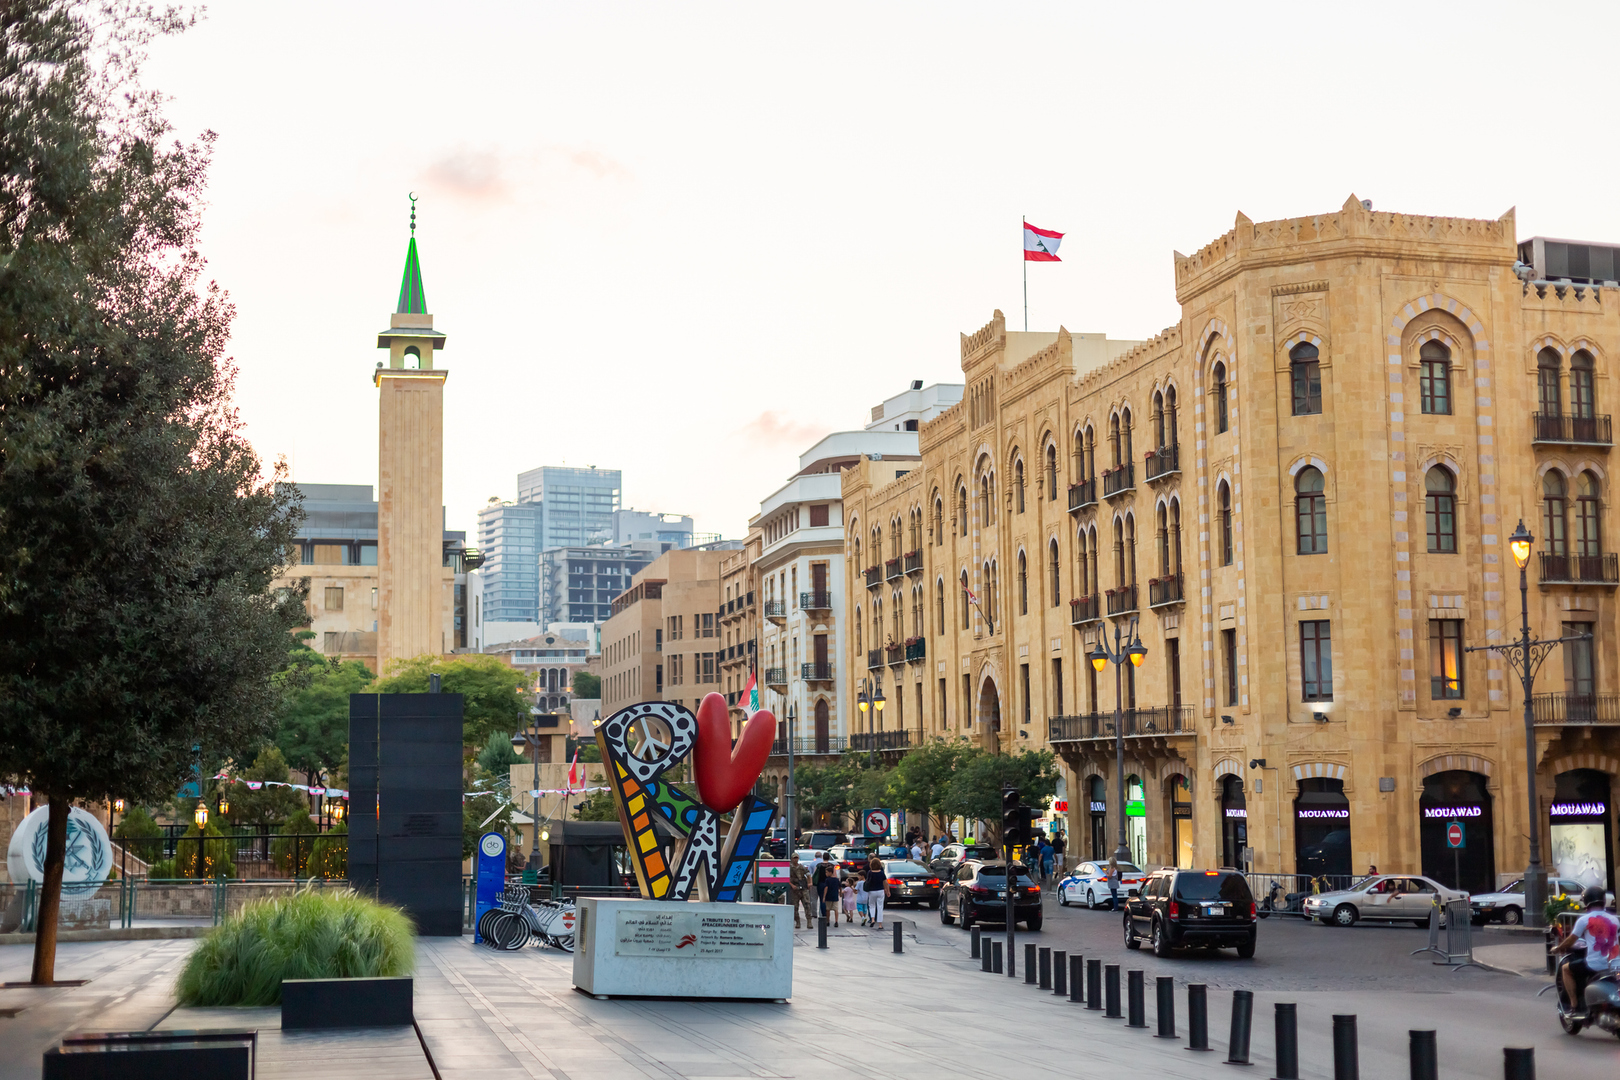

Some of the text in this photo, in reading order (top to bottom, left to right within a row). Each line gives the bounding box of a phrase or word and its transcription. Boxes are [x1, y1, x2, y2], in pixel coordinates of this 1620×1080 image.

[1226, 808, 1248, 818] MOUAWA
[1299, 810, 1349, 818] MOUAWAD
[1424, 806, 1482, 818] MOUAWAD
[1550, 802, 1606, 816] MOUAWAD
